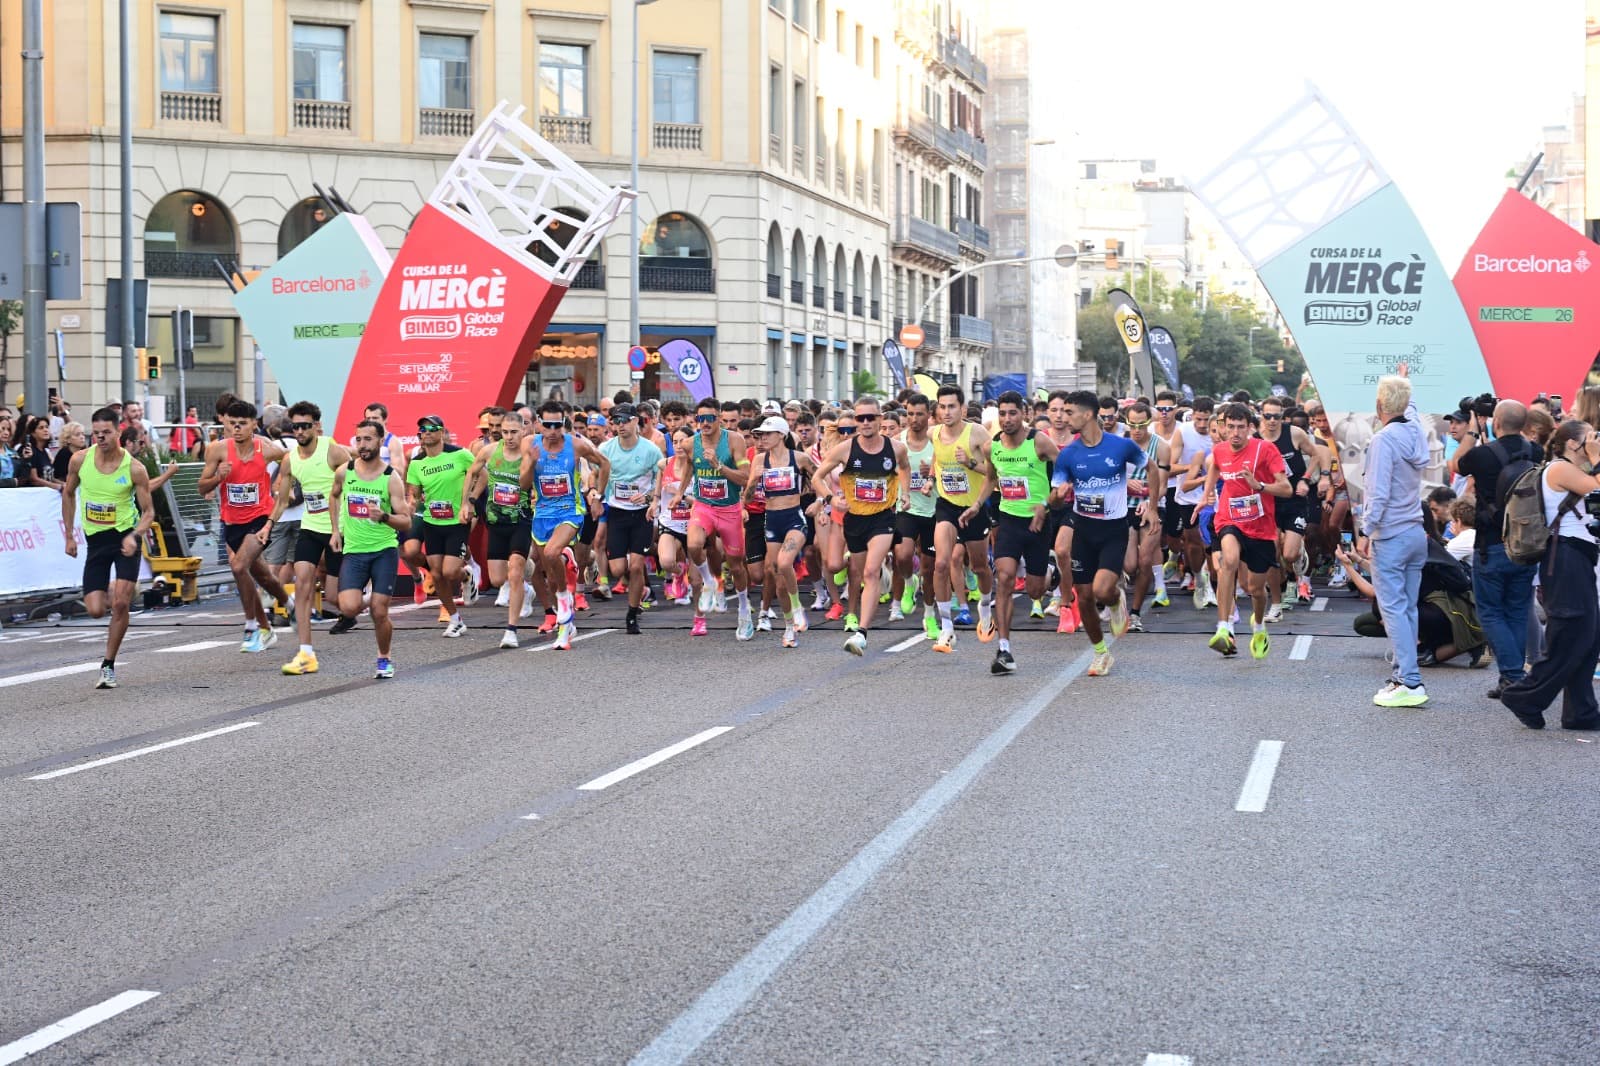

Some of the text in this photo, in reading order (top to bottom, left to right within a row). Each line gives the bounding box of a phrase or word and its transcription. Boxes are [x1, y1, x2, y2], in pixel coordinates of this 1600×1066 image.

[1310, 248, 1382, 258] CURSA DE LA
[1474, 254, 1572, 273] Barcelona
[402, 264, 467, 277] CURSA DE LA
[1304, 253, 1426, 295] MERCÈ
[272, 275, 356, 294] Barcelona
[399, 268, 507, 310] MERCÈ
[1377, 299, 1421, 312] Global
[464, 312, 504, 324] Global
[1308, 306, 1369, 320] BIMBO
[1376, 313, 1413, 325] Race
[1555, 309, 1573, 322] 26
[405, 320, 457, 335] BIMBO
[464, 325, 498, 337] Race
[1413, 344, 1426, 354] 20
[440, 353, 453, 363] 20
[399, 363, 451, 374] SETEMBRE
[398, 383, 440, 393] FAMILIAR
[864, 490, 876, 498] 29
[356, 506, 368, 514] 30
